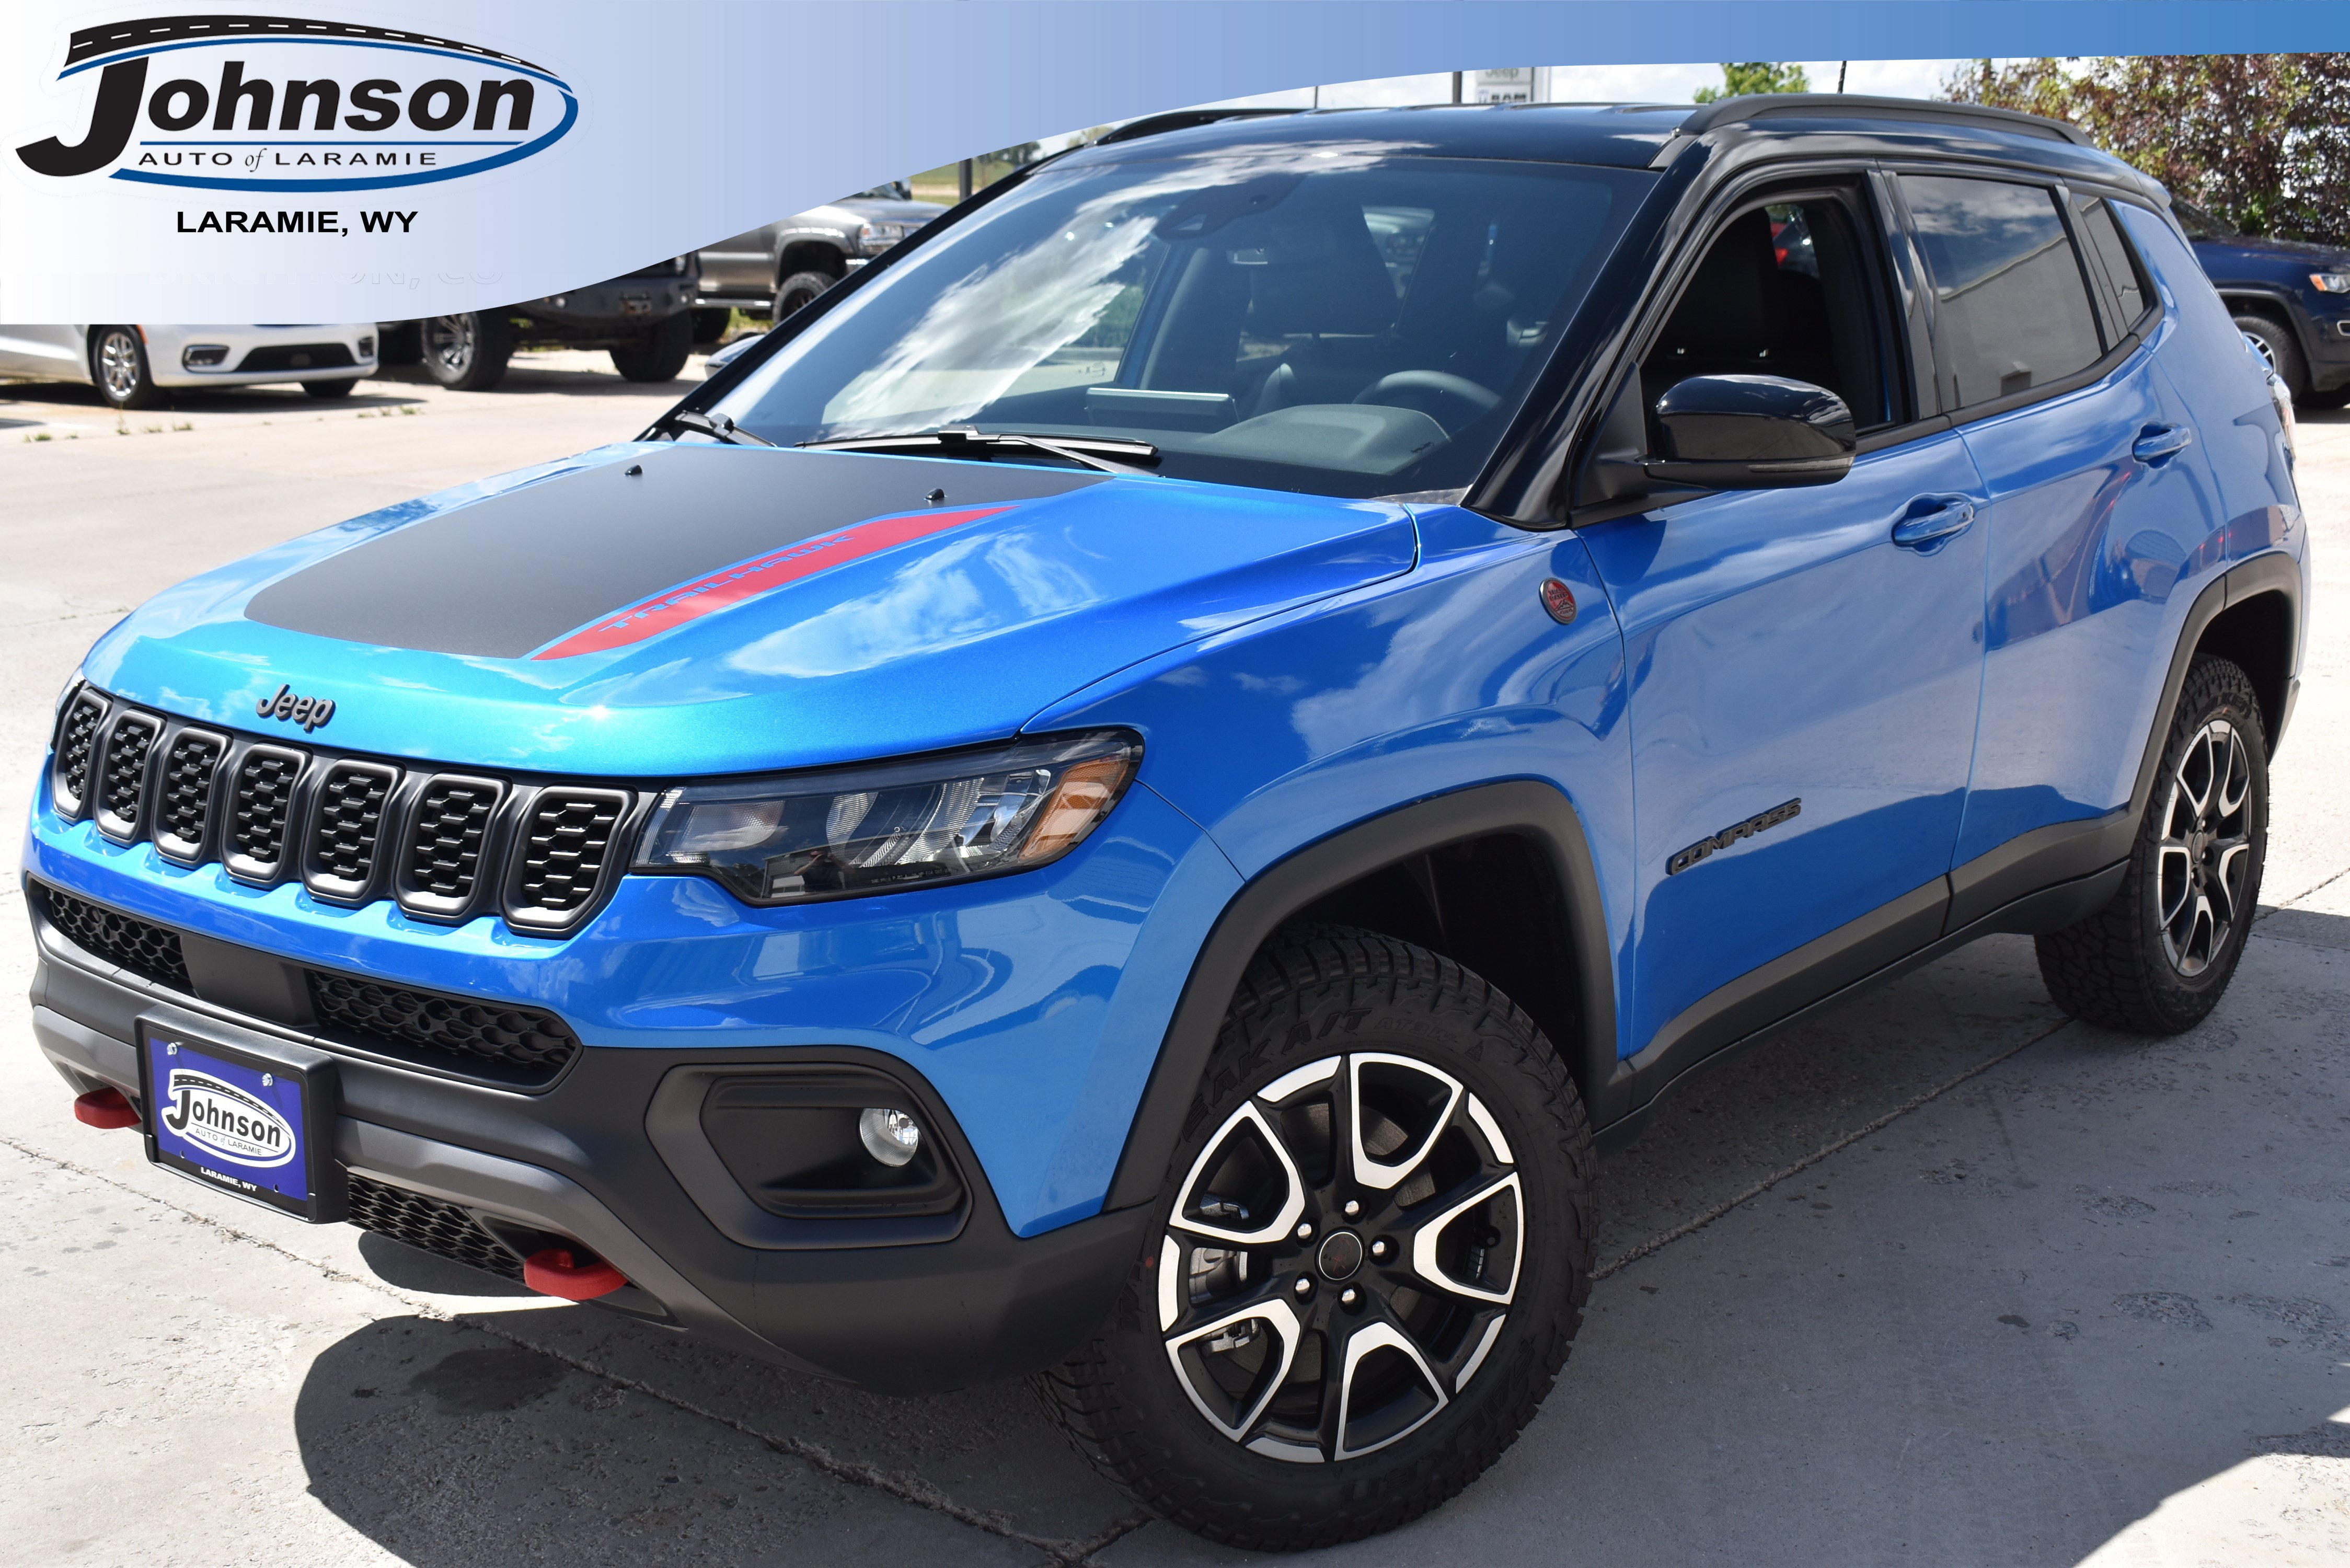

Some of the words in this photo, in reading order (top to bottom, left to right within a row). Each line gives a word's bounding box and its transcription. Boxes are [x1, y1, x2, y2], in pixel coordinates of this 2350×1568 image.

[597, 534, 858, 633] TRAILHAWK
[256, 683, 336, 734] Jeep
[1665, 797, 1802, 876] COMPASS
[166, 1090, 281, 1147] Johnson
[195, 1128, 218, 1141] AUTO
[220, 1135, 227, 1146] of
[228, 1139, 262, 1156] LARAMIE
[201, 1167, 241, 1188] LARAMIE,
[242, 1181, 257, 1192] WY
